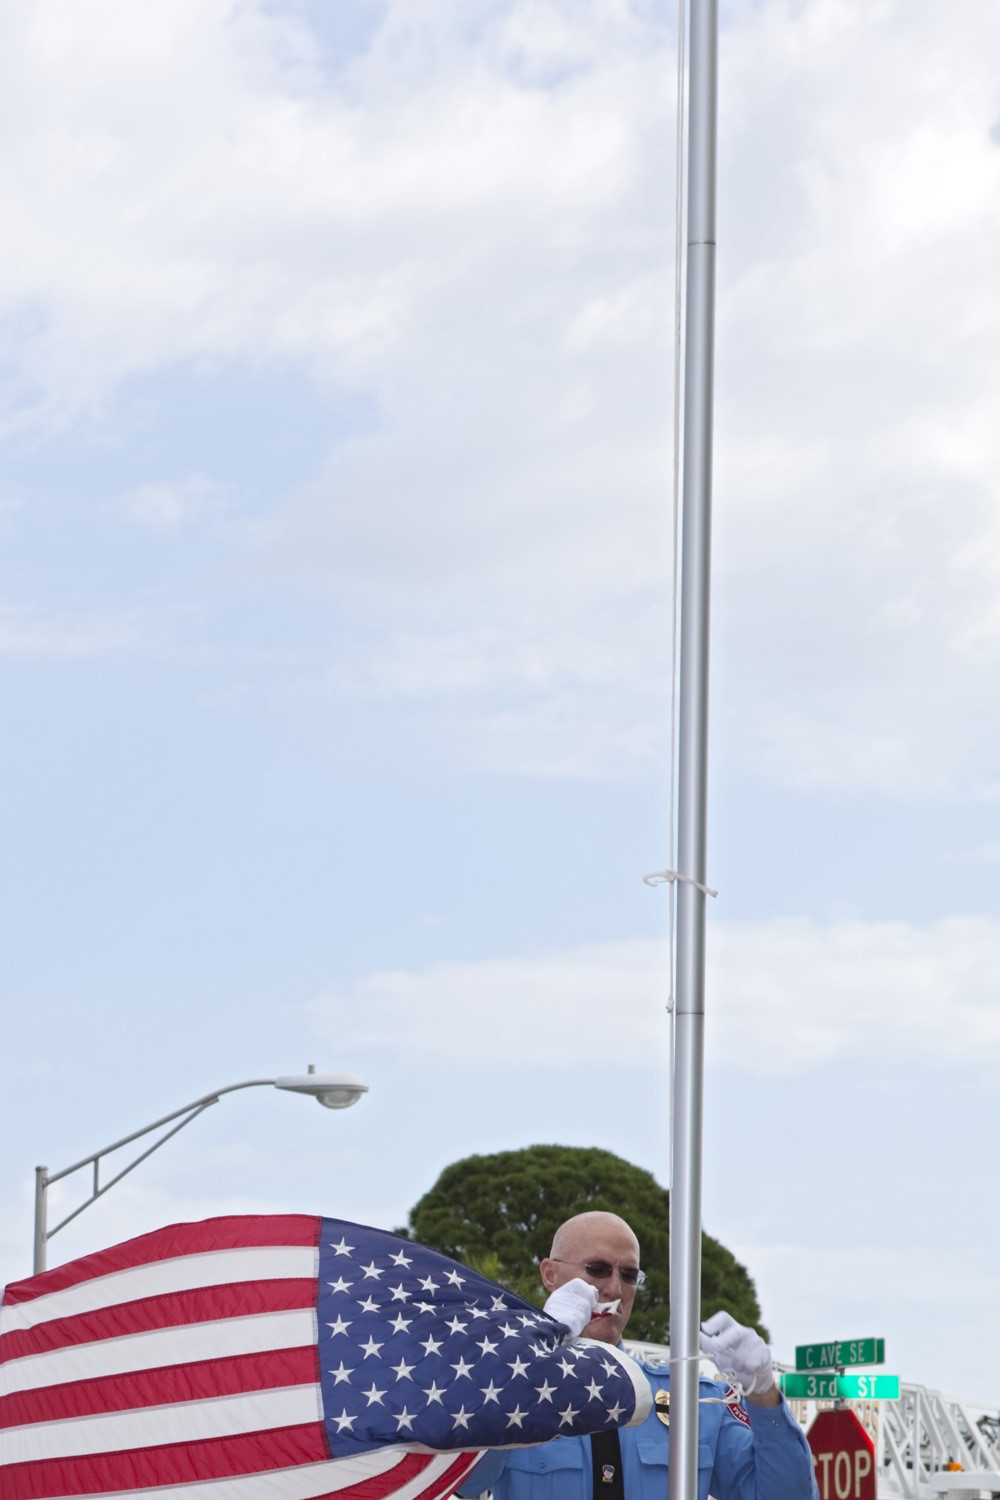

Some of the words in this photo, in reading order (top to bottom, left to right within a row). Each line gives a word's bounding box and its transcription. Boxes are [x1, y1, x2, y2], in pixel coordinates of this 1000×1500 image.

[806, 1348, 813, 1367] C
[820, 1345, 842, 1366] AVE
[850, 1342, 865, 1363] SE
[807, 1376, 837, 1396] 3rd
[857, 1376, 877, 1397] ST
[812, 1449, 871, 1500] TOP
